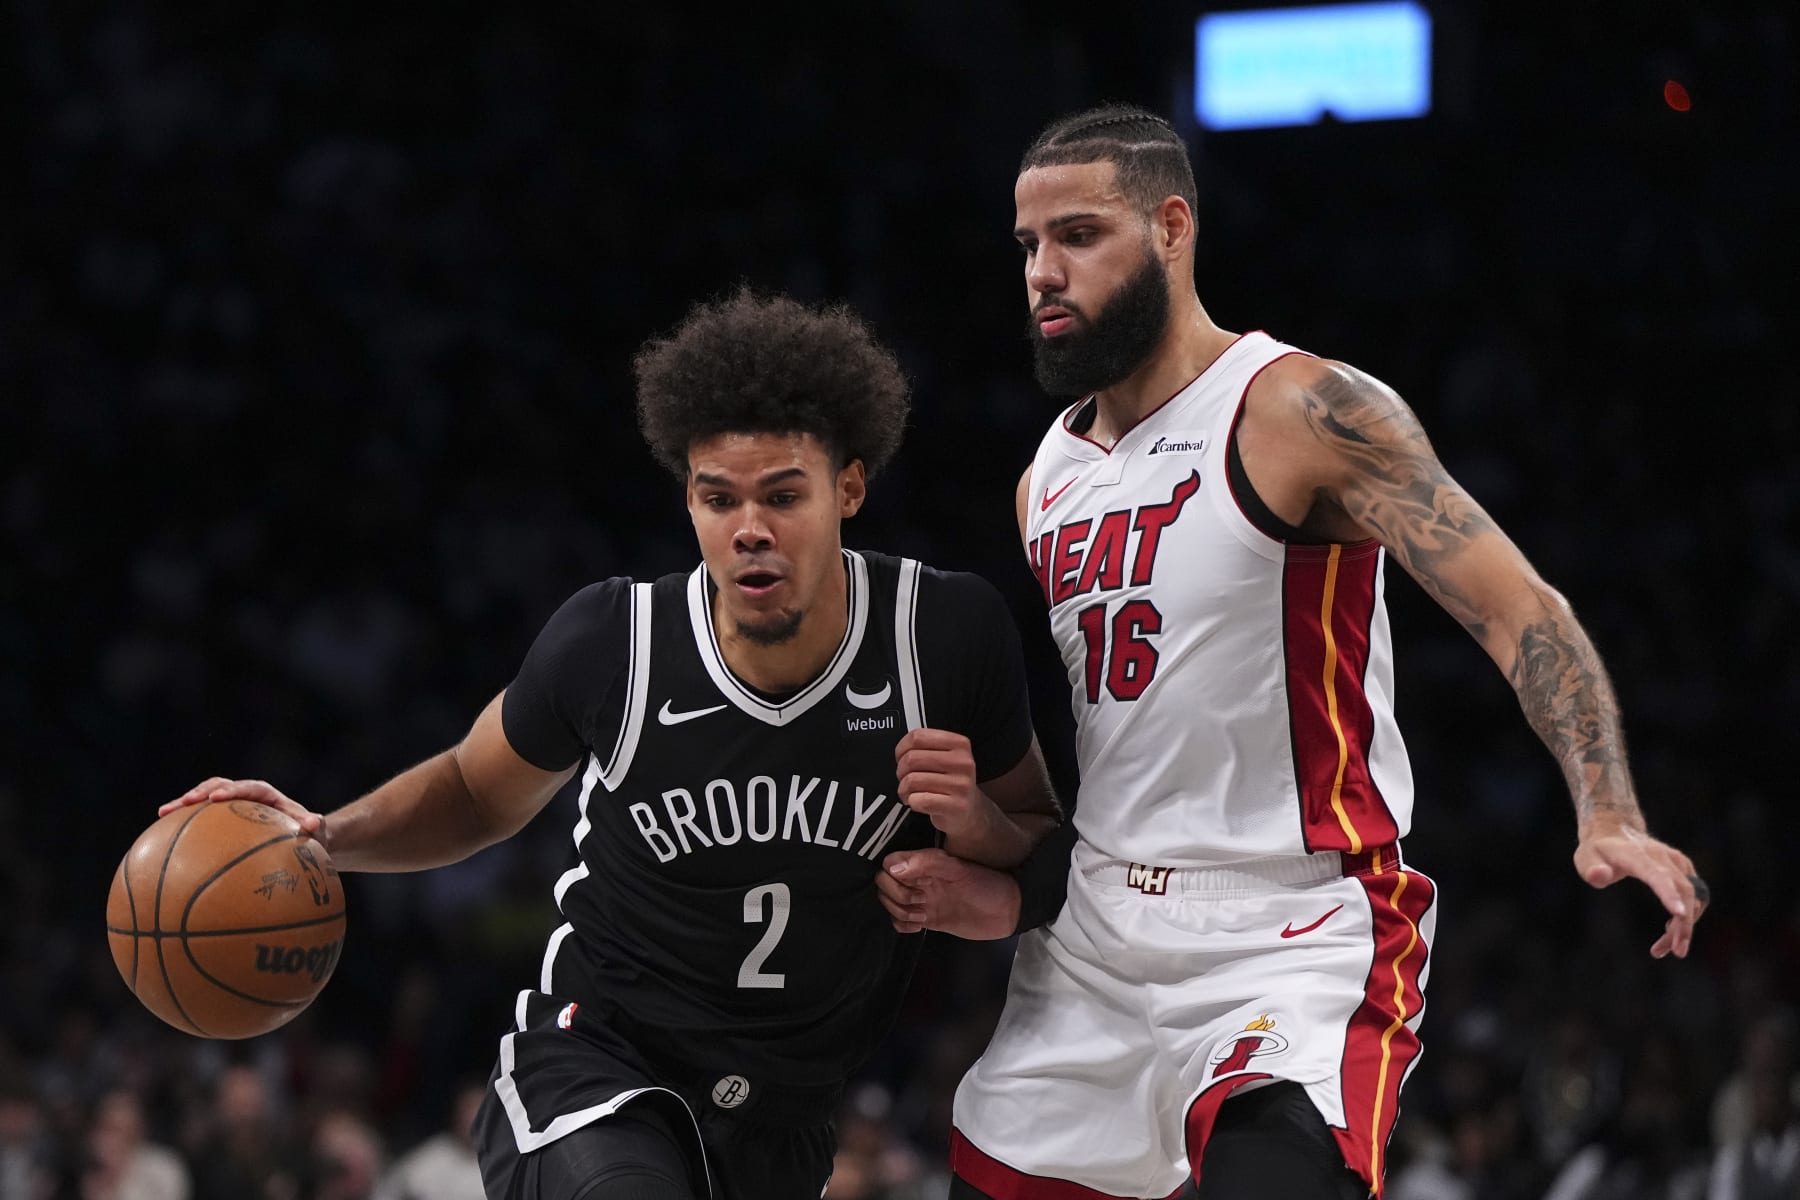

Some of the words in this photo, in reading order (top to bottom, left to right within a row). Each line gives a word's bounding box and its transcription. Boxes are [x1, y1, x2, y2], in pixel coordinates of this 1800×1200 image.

[1160, 440, 1203, 452] Carnival
[1029, 468, 1201, 608] HEAT
[1078, 600, 1162, 704] 16
[847, 716, 894, 731] Webull
[629, 774, 912, 863] BROOKLYN
[737, 882, 791, 988] 2
